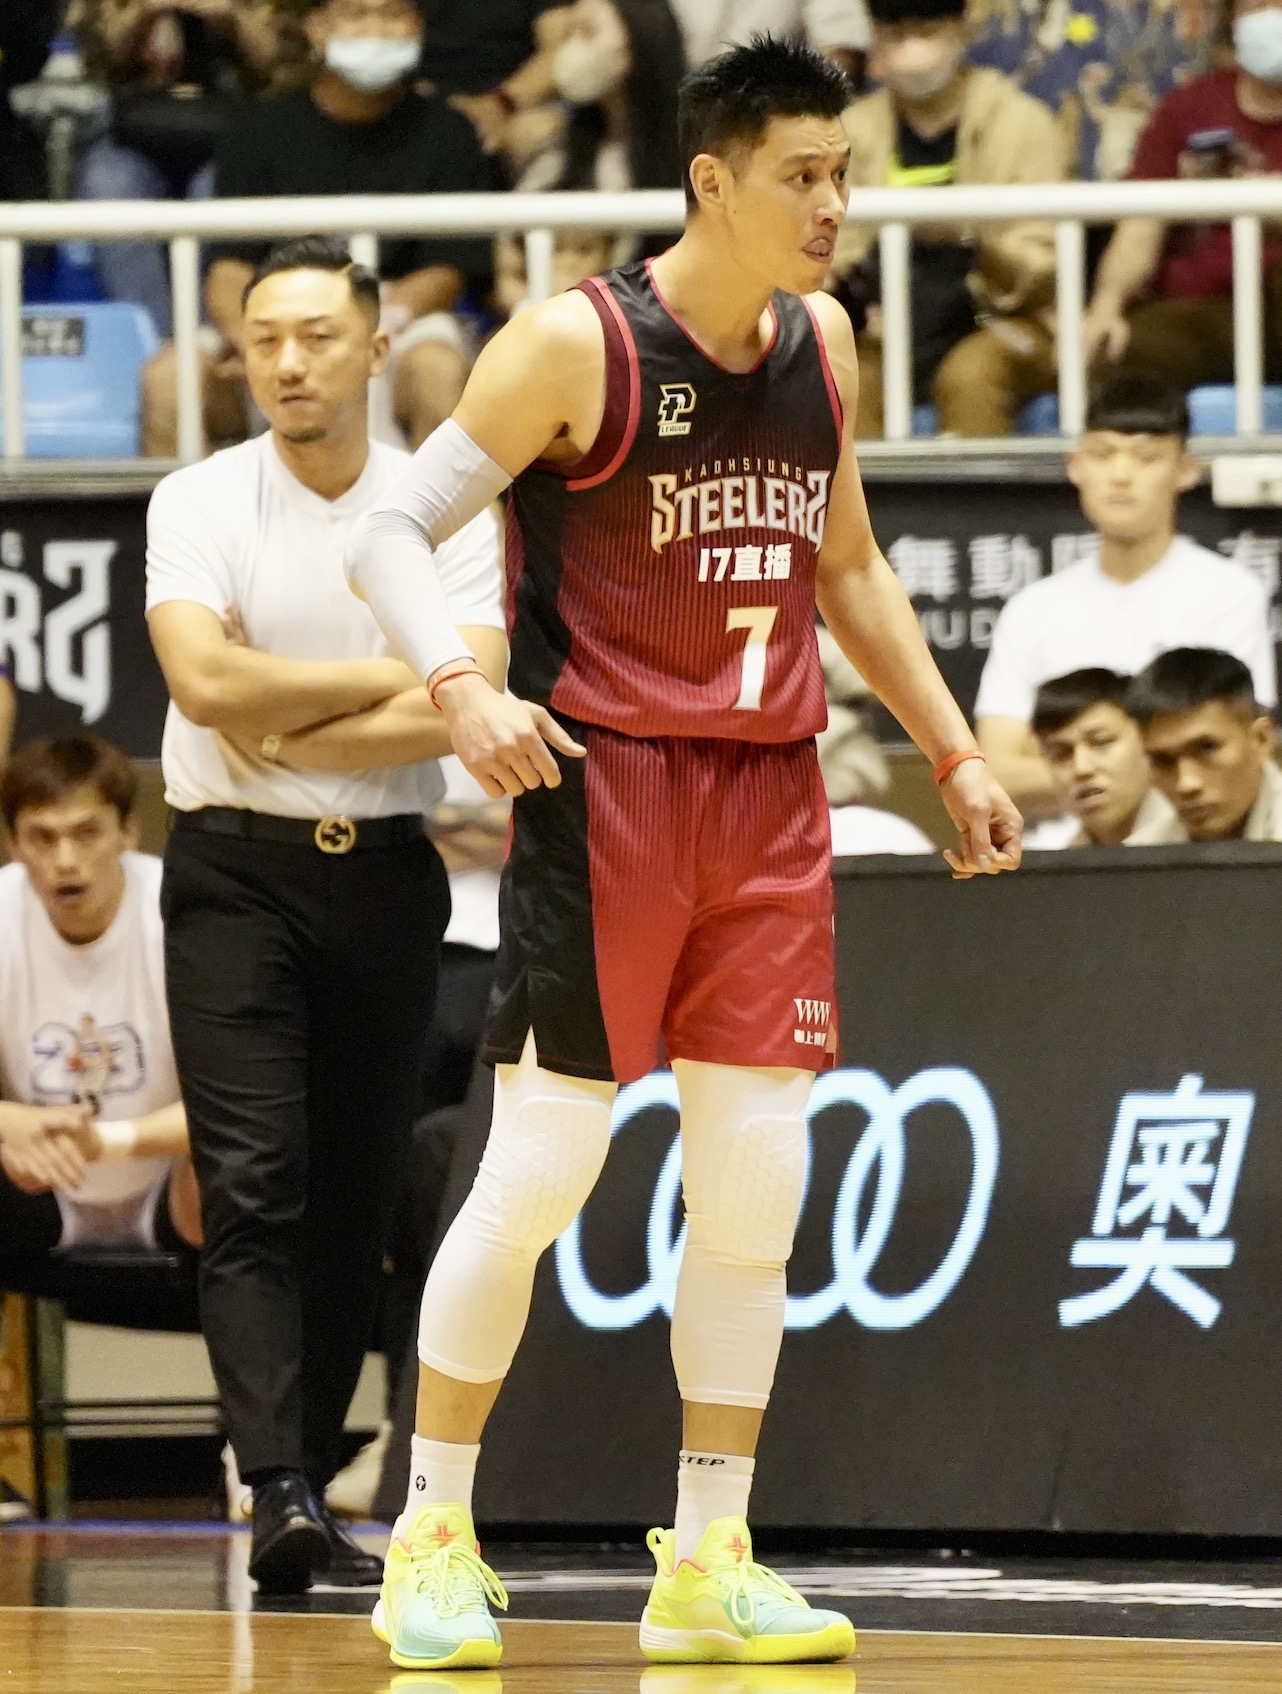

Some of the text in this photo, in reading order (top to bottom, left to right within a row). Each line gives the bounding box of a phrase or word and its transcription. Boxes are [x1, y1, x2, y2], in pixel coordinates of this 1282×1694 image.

[684, 457, 803, 482] KAOHSIUNG
[698, 543, 792, 582] 17直播
[726, 606, 778, 712] 7
